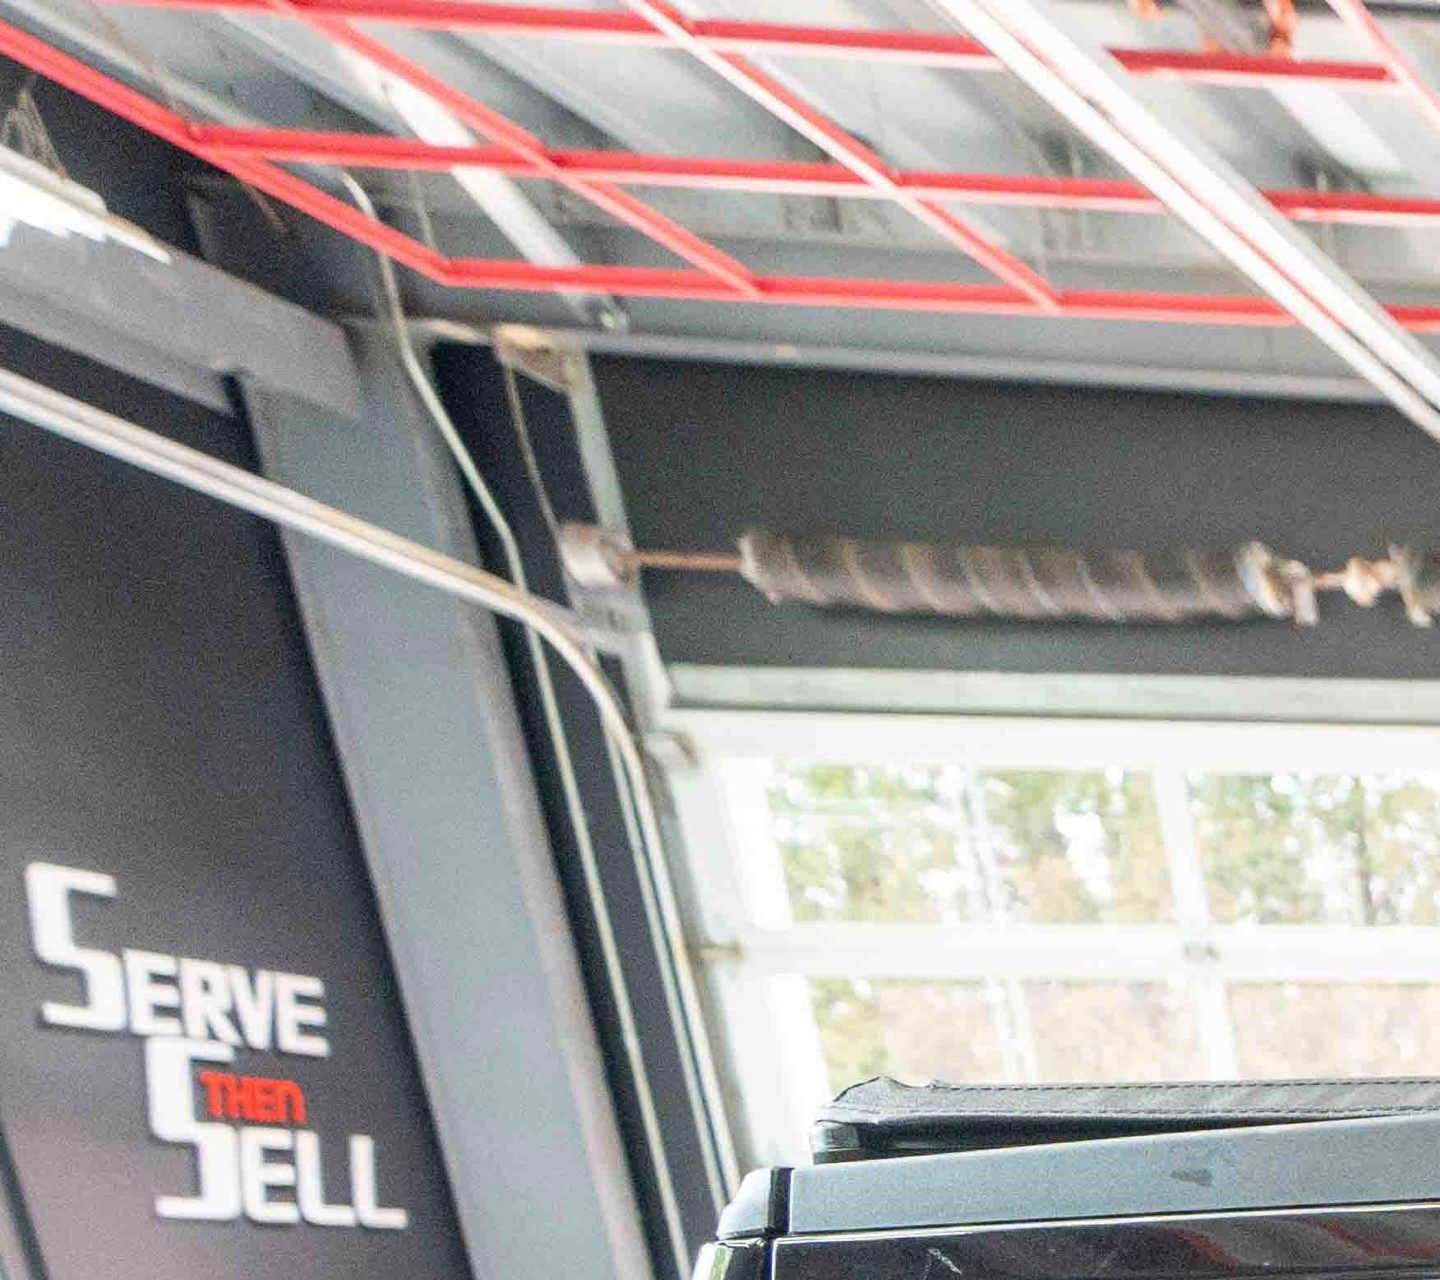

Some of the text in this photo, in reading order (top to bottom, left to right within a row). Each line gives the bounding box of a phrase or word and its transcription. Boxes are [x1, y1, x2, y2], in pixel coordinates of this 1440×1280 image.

[25, 862, 330, 1057] SERVE
[146, 1036, 408, 1229] SELL
[199, 1071, 306, 1124] THEN
